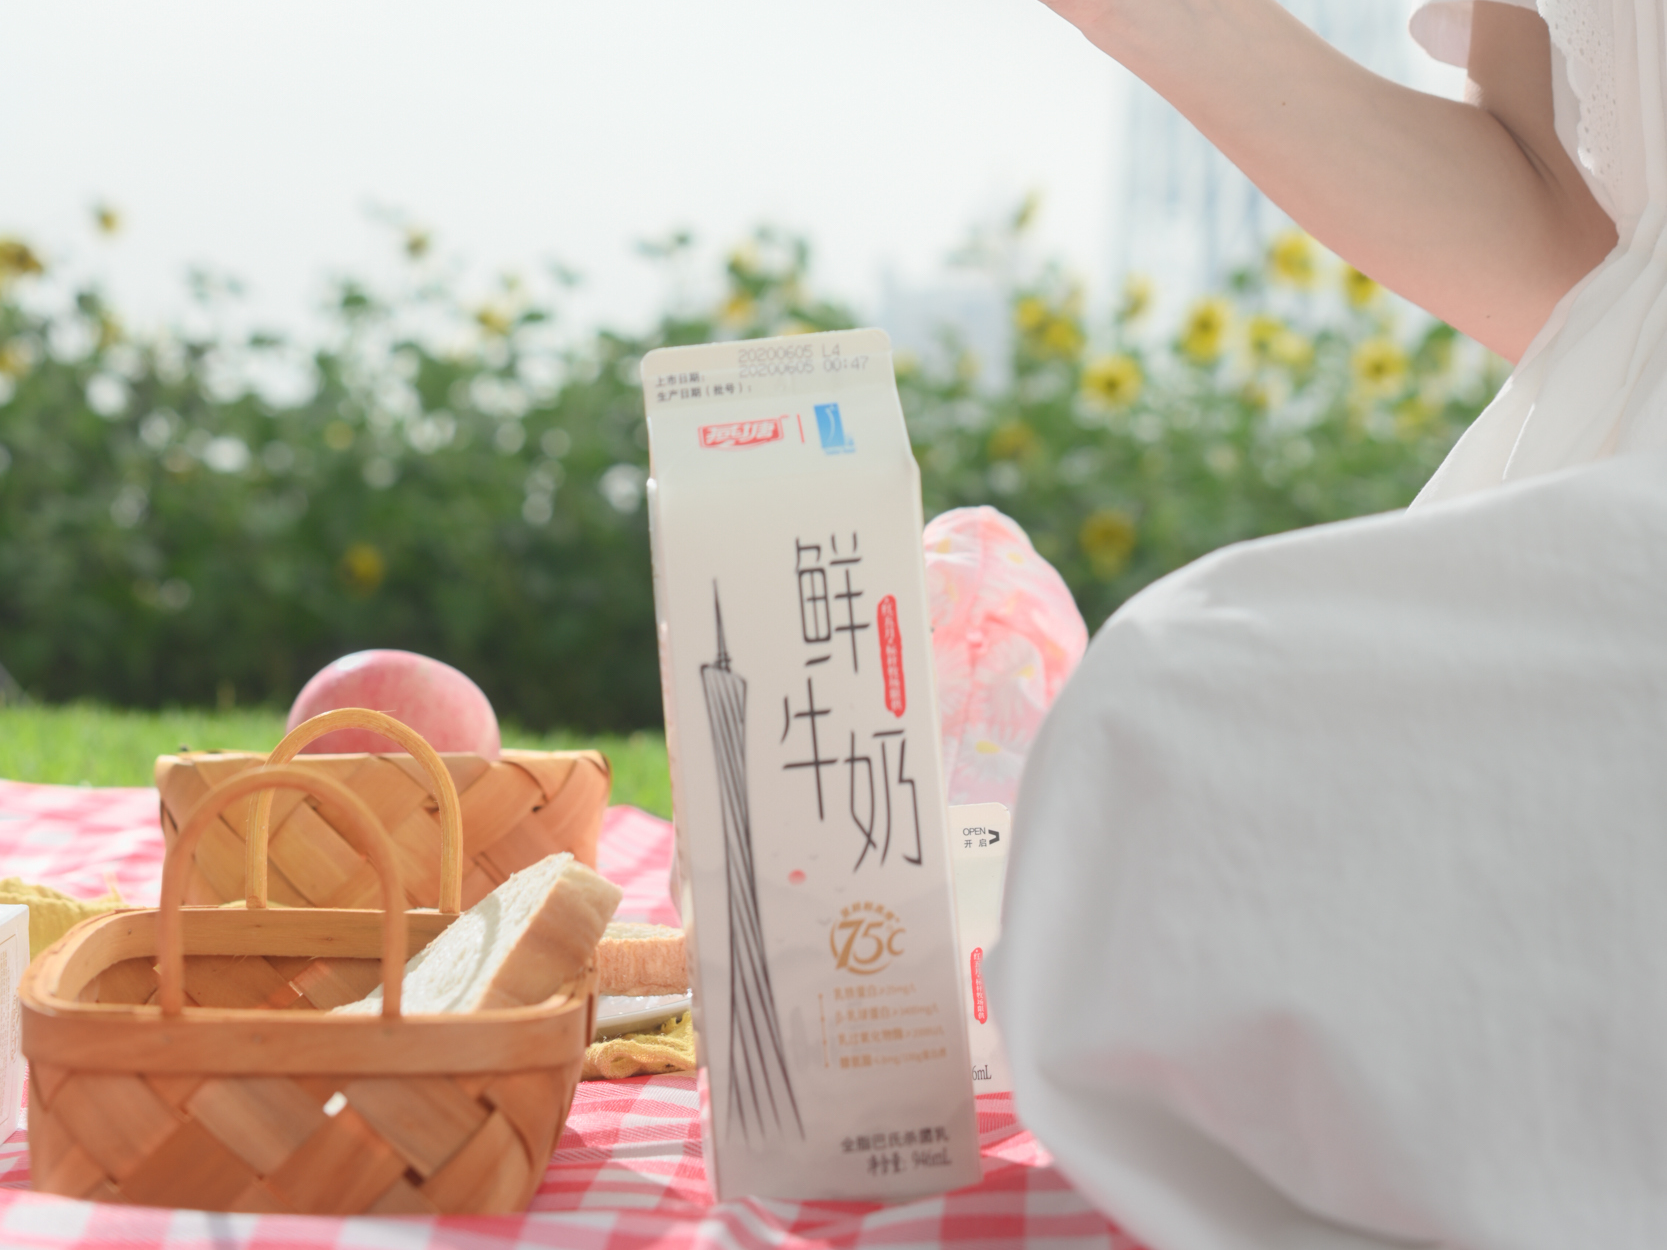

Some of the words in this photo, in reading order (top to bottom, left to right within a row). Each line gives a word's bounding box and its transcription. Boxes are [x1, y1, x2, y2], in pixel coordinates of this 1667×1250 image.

[738, 344, 813, 363] 20200605
[822, 343, 840, 358] L4
[739, 359, 815, 378] 20200605
[823, 355, 869, 373] 00:47
[962, 827, 986, 837] OPEN
